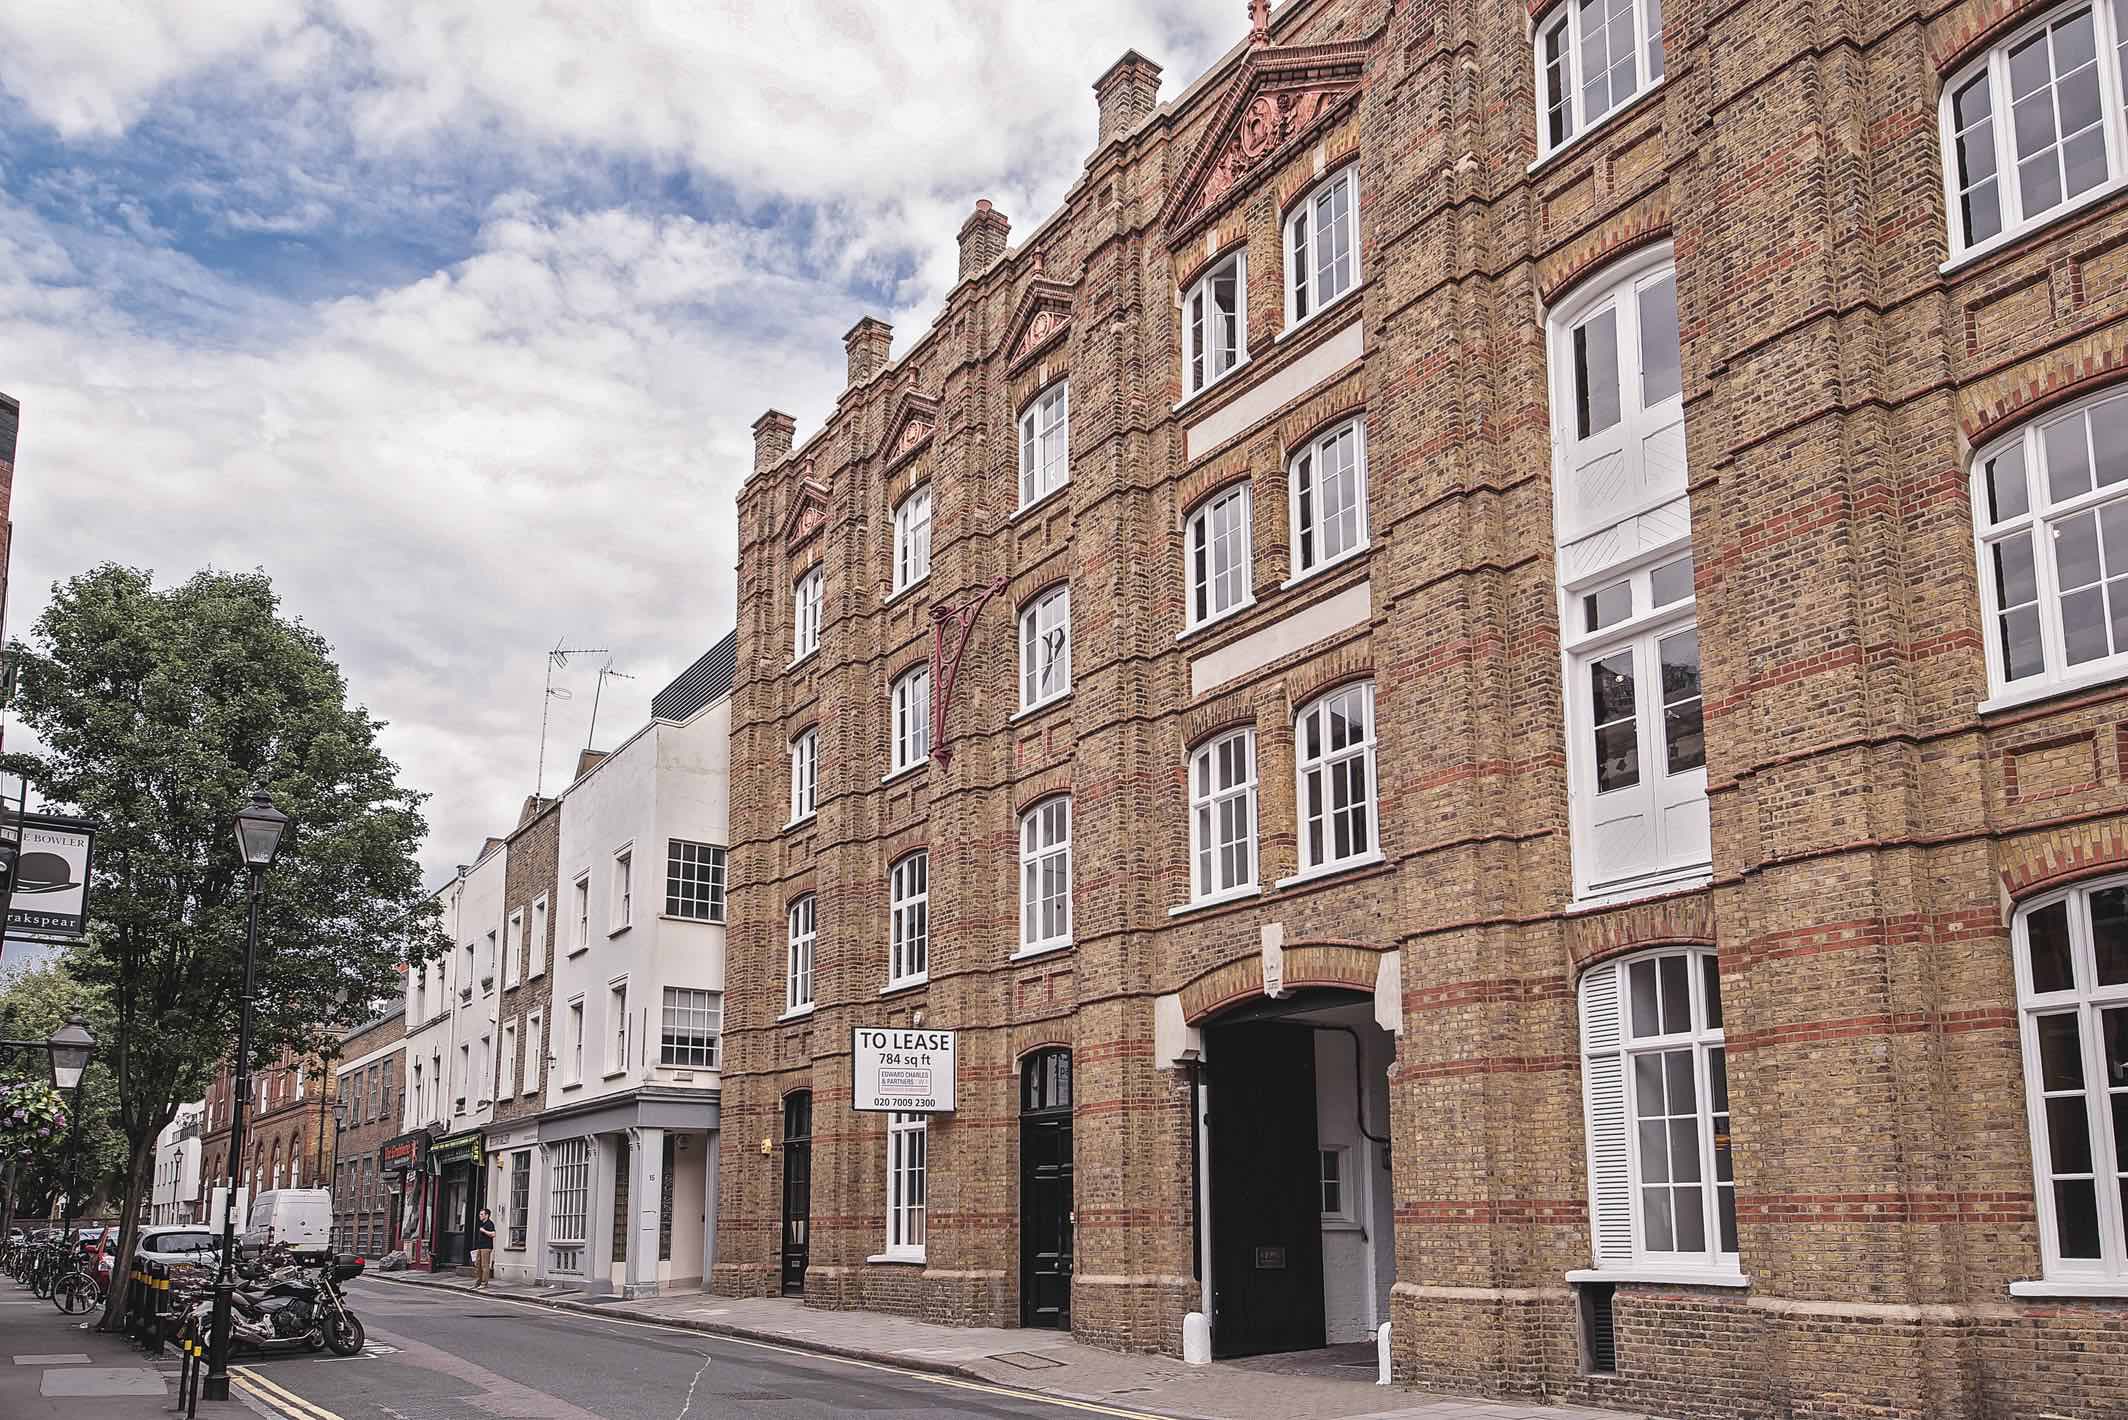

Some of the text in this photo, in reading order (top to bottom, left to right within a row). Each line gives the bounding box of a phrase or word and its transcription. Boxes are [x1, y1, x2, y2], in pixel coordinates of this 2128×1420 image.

[34, 834, 85, 848] BOWLER
[7, 913, 76, 927] rakspear
[860, 1032, 950, 1051] TO LEASE
[879, 1053, 931, 1068] 784 sq ft
[874, 1098, 936, 1108] 020 7009 2300
